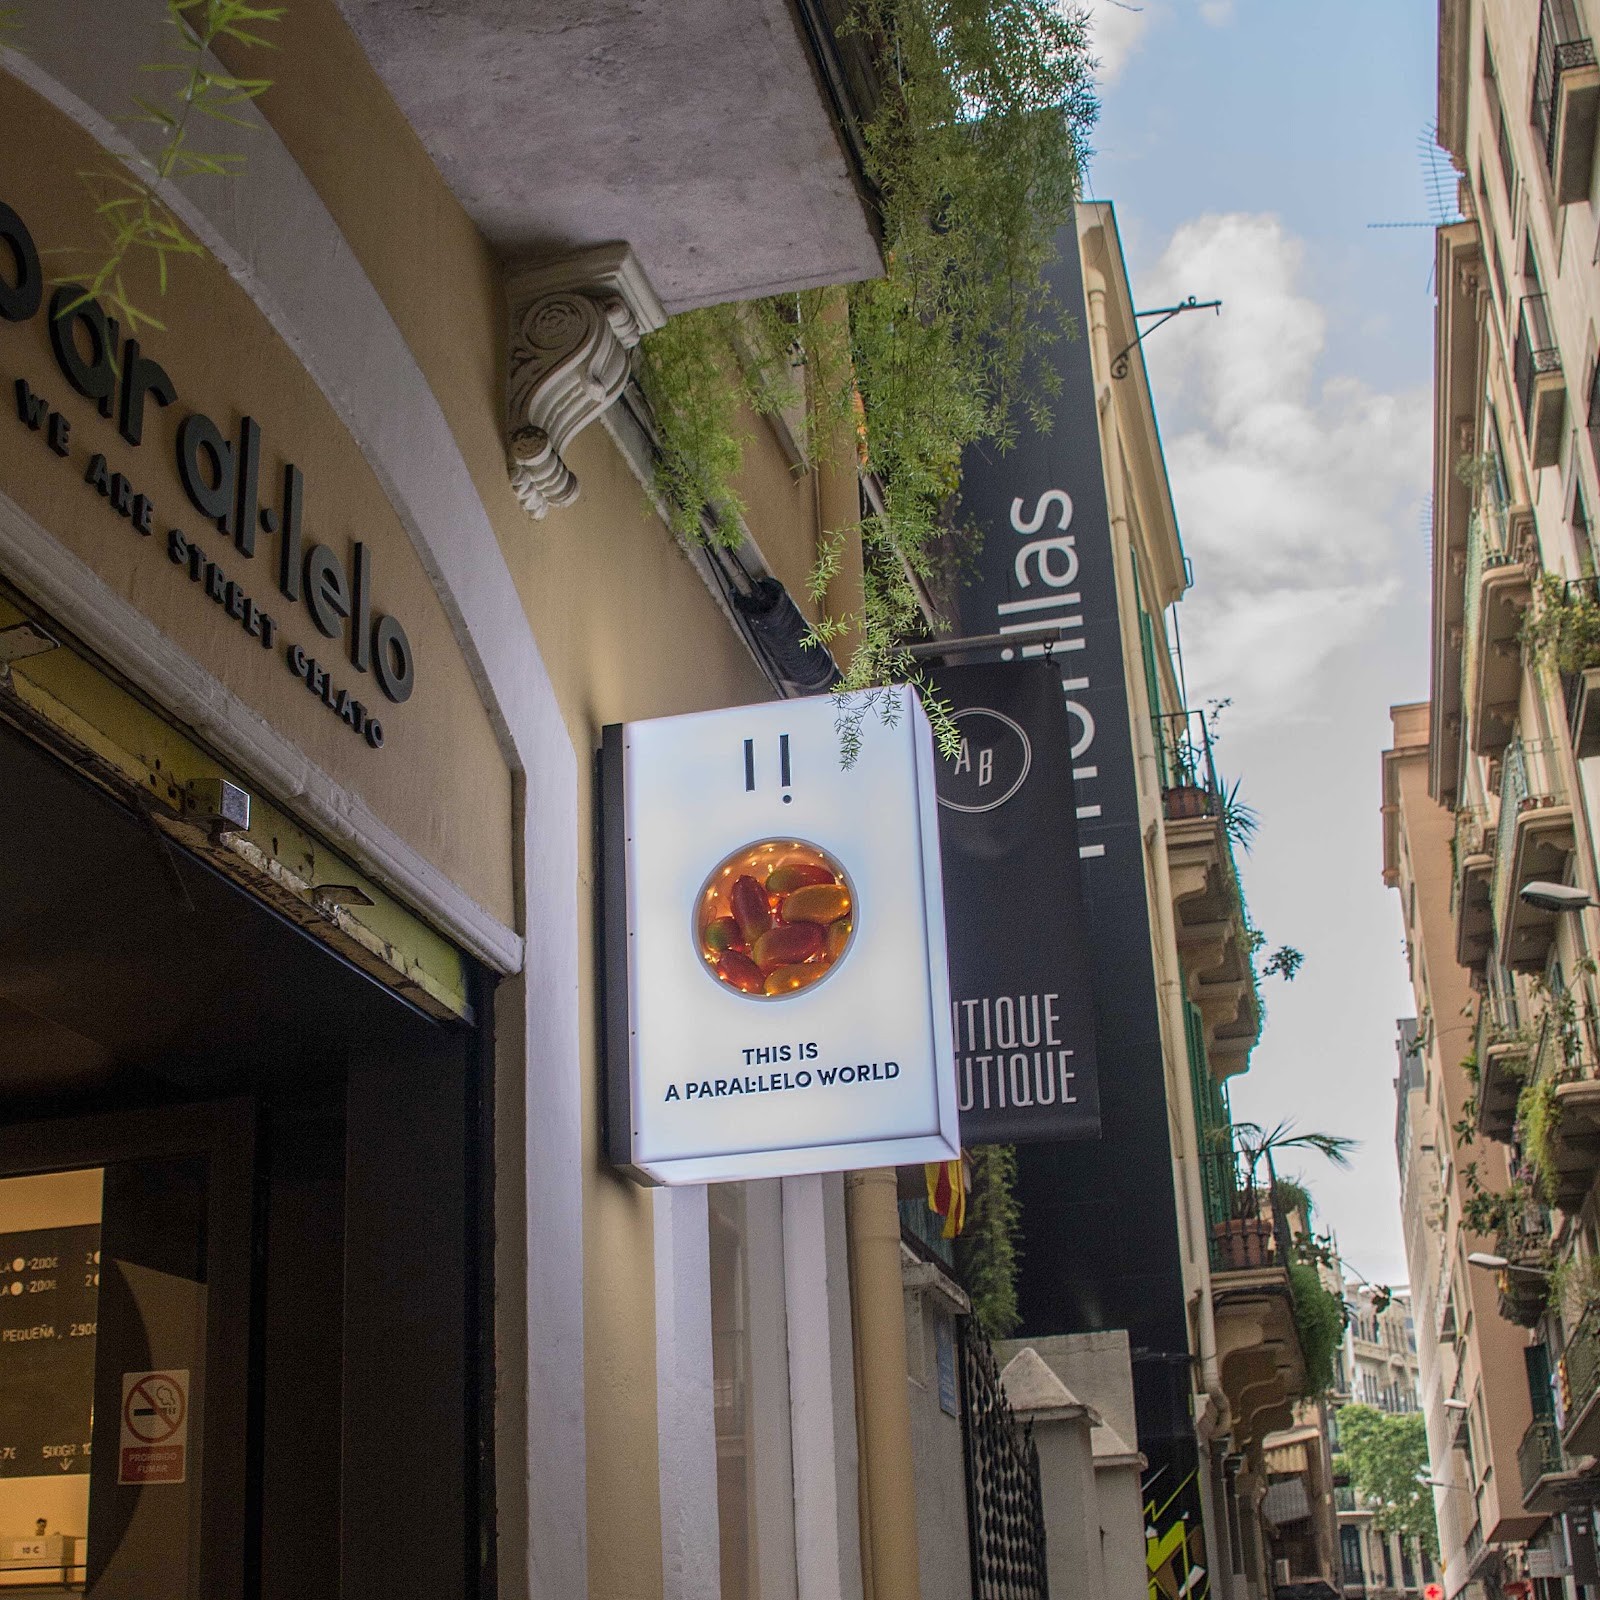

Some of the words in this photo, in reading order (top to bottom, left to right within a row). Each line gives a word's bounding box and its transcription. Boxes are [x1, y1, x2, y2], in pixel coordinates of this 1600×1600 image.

[15, 378, 70, 457] WE
[85, 453, 154, 536] ARE
[168, 528, 278, 649] STREET
[287, 643, 385, 749] GELATO
[952, 993, 1062, 1052] TIQUE
[664, 1084, 681, 1102] A
[816, 1061, 900, 1086] WORLD
[741, 1045, 792, 1066] THIS
[798, 1042, 819, 1060] IS
[956, 1050, 1077, 1112] UTIQUE
